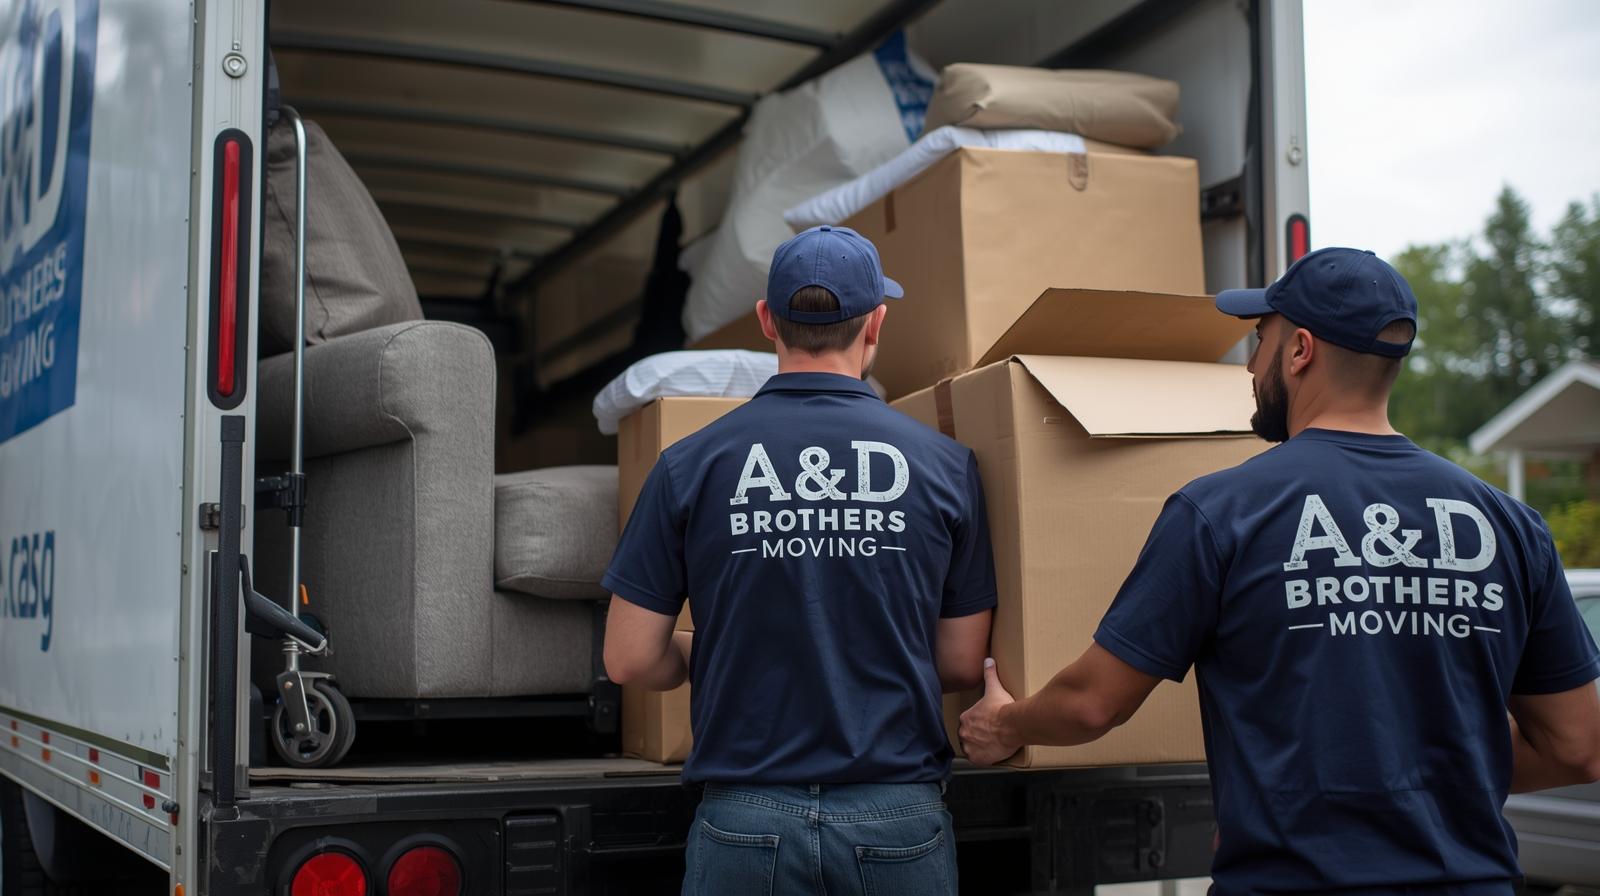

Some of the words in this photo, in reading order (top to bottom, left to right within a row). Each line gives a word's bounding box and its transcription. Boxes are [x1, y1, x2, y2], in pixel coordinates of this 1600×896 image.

[730, 440, 909, 505] A&D
[730, 508, 906, 535] BROTHERS
[1283, 494, 1497, 572] A&D
[762, 537, 877, 558] MOVING
[1285, 575, 1504, 611] BROTHERS
[1329, 610, 1471, 638] MOVING
